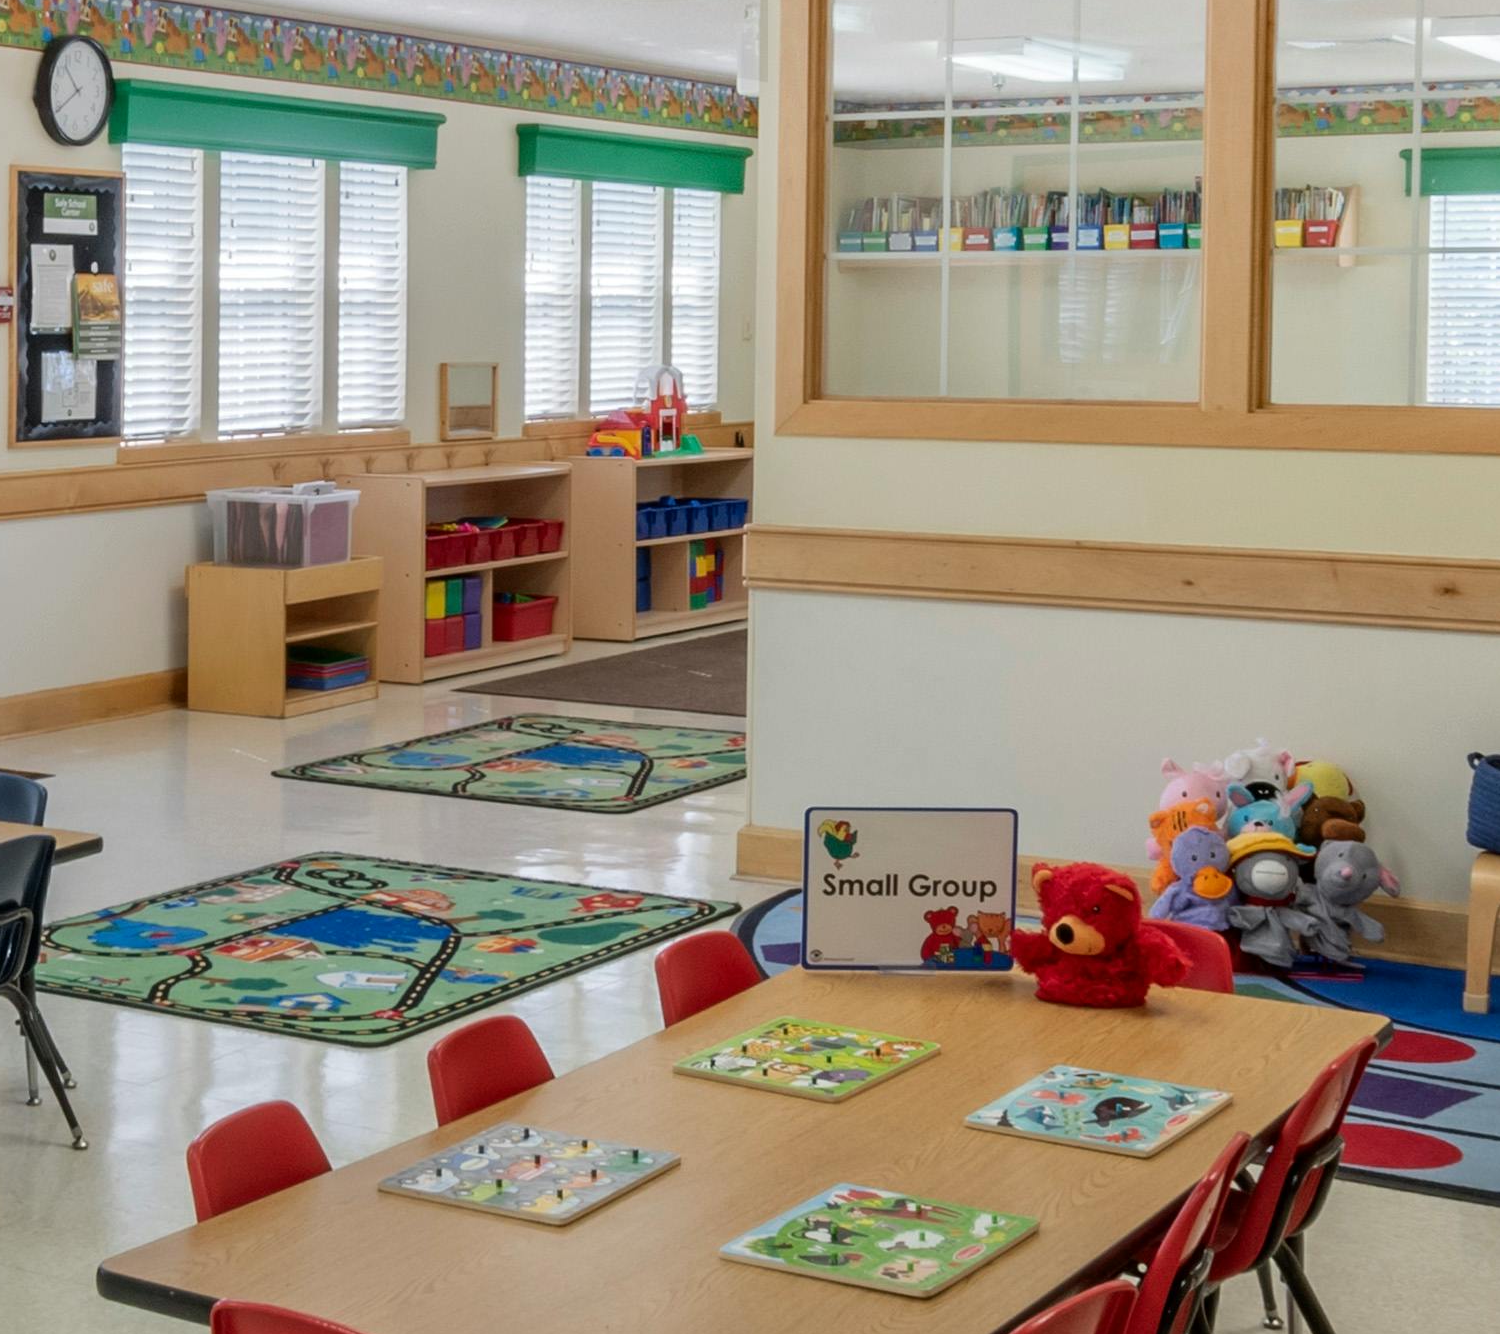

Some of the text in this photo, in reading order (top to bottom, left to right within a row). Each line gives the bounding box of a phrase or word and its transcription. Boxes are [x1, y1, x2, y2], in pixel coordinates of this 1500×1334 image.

[92, 278, 114, 294] safe
[822, 873, 997, 903] Small Group
